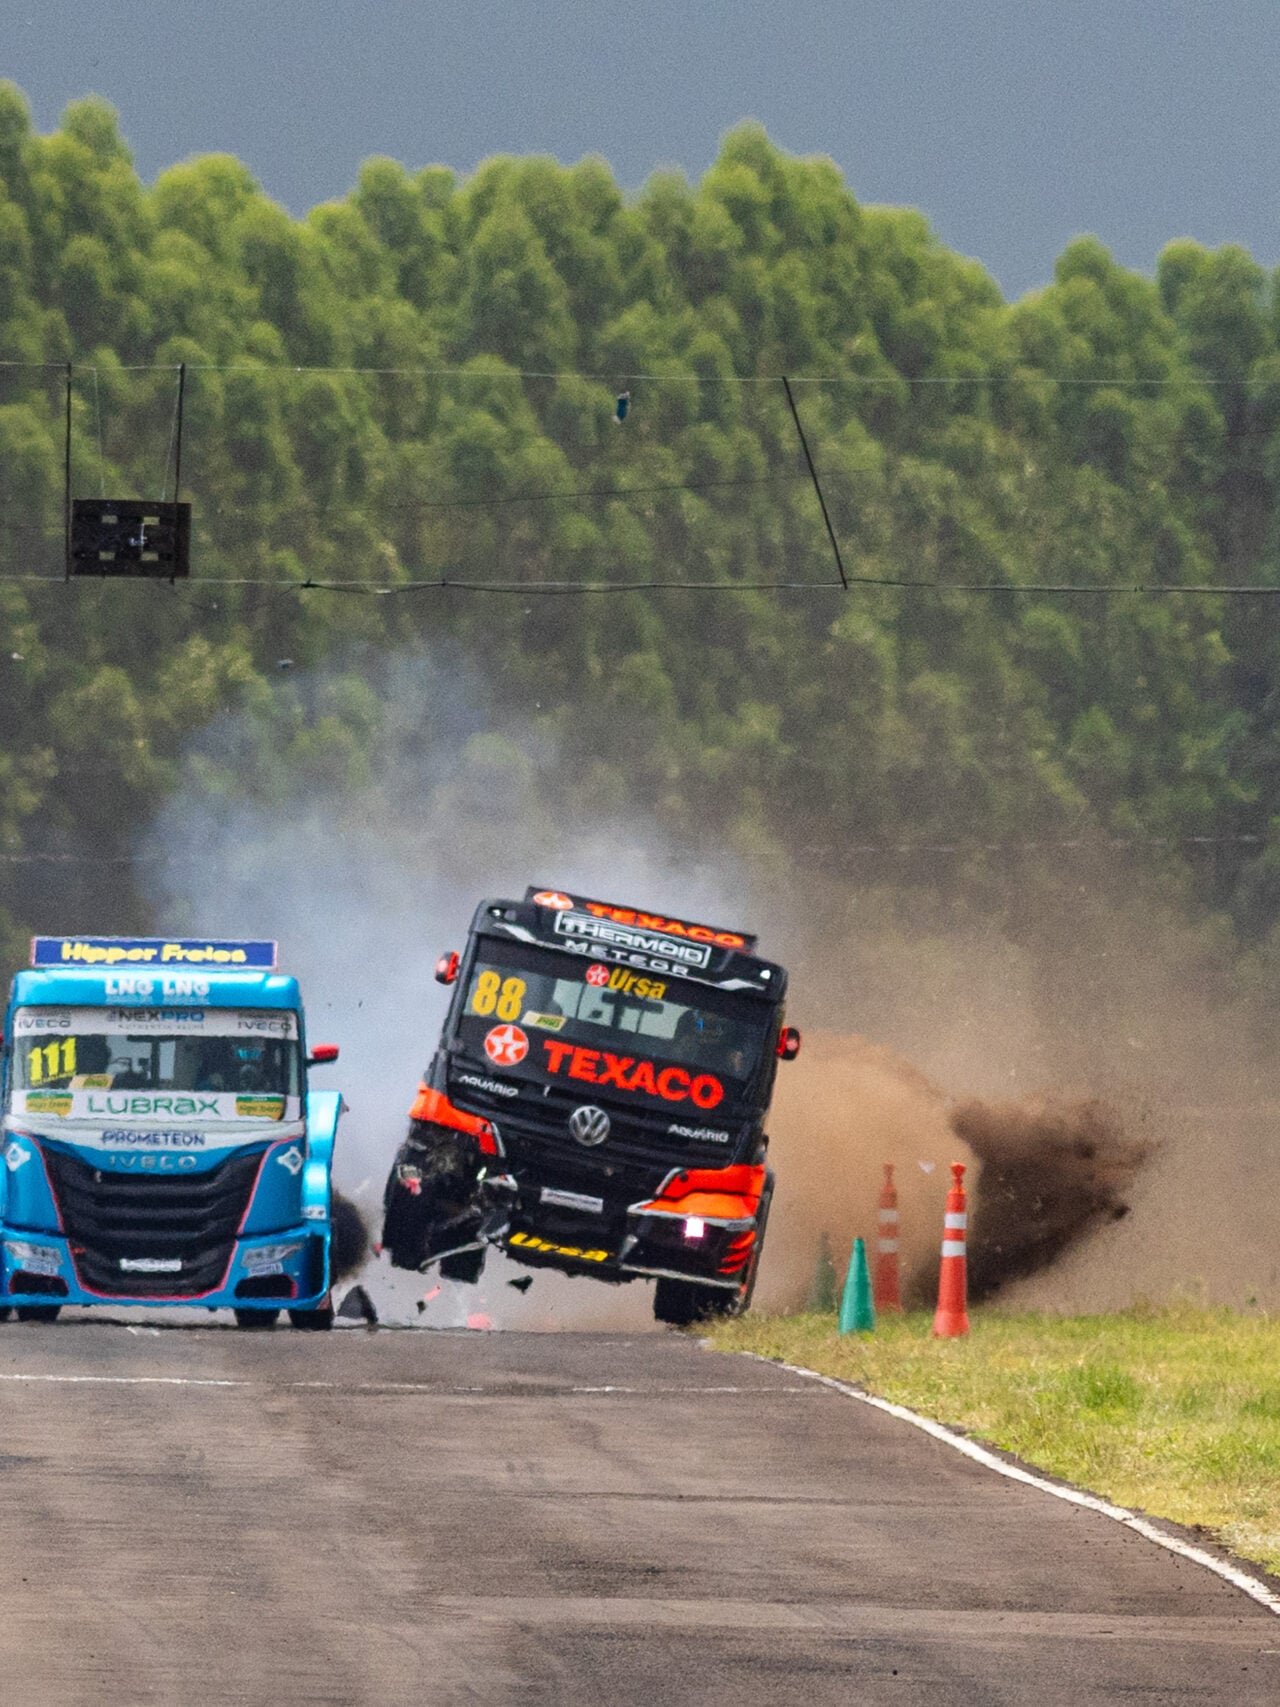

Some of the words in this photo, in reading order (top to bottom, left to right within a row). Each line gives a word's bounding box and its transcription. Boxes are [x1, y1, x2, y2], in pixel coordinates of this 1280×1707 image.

[562, 917, 704, 964] THERMOID
[585, 903, 745, 948] TEXACO
[565, 939, 689, 976] METEOR
[471, 969, 527, 1022] 88
[609, 967, 667, 1000] Ursa
[18, 1018, 71, 1029] IVECO
[120, 1009, 205, 1022] NEXPRO
[27, 1036, 77, 1083] 111
[543, 1039, 725, 1109] TEXACO
[101, 1130, 205, 1146] PROMETEON
[109, 1155, 198, 1170] IVECO
